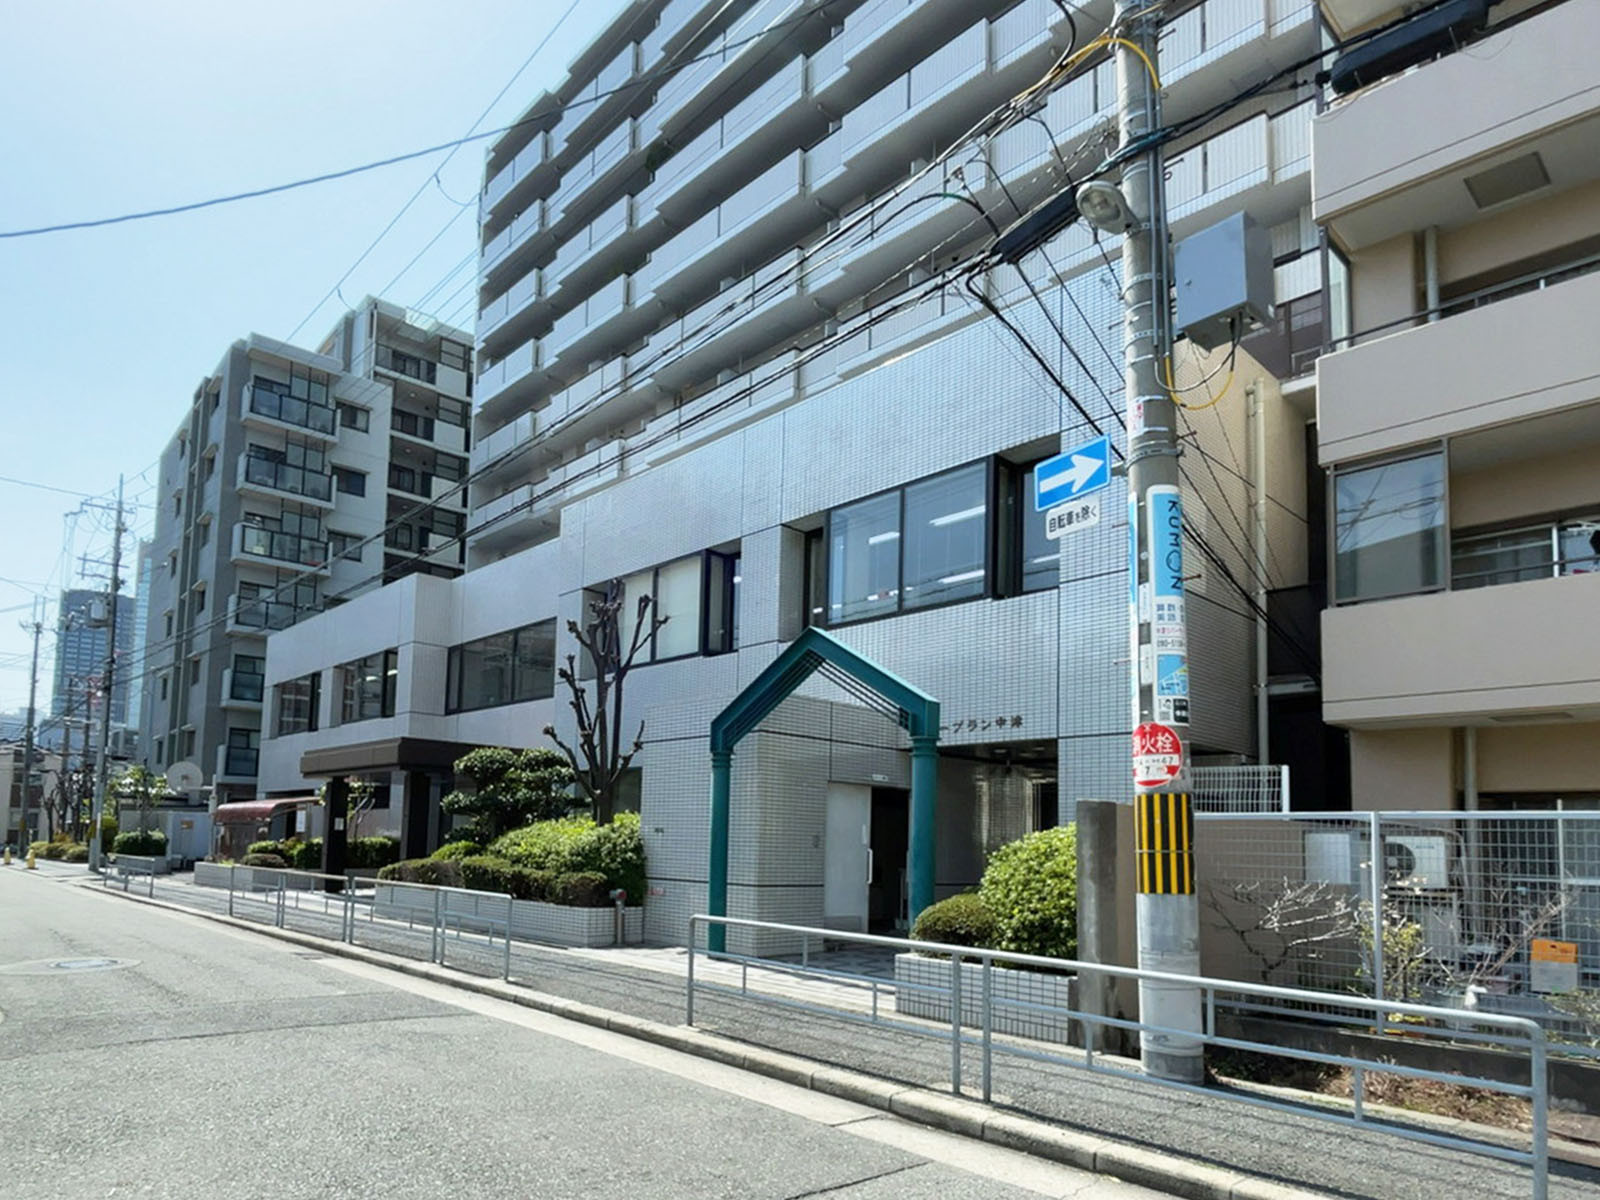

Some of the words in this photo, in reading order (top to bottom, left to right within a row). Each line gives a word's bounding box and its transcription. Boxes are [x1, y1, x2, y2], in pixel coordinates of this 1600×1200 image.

[1048, 504, 1097, 533] 自転車を除く
[1166, 499, 1183, 591] KUMON
